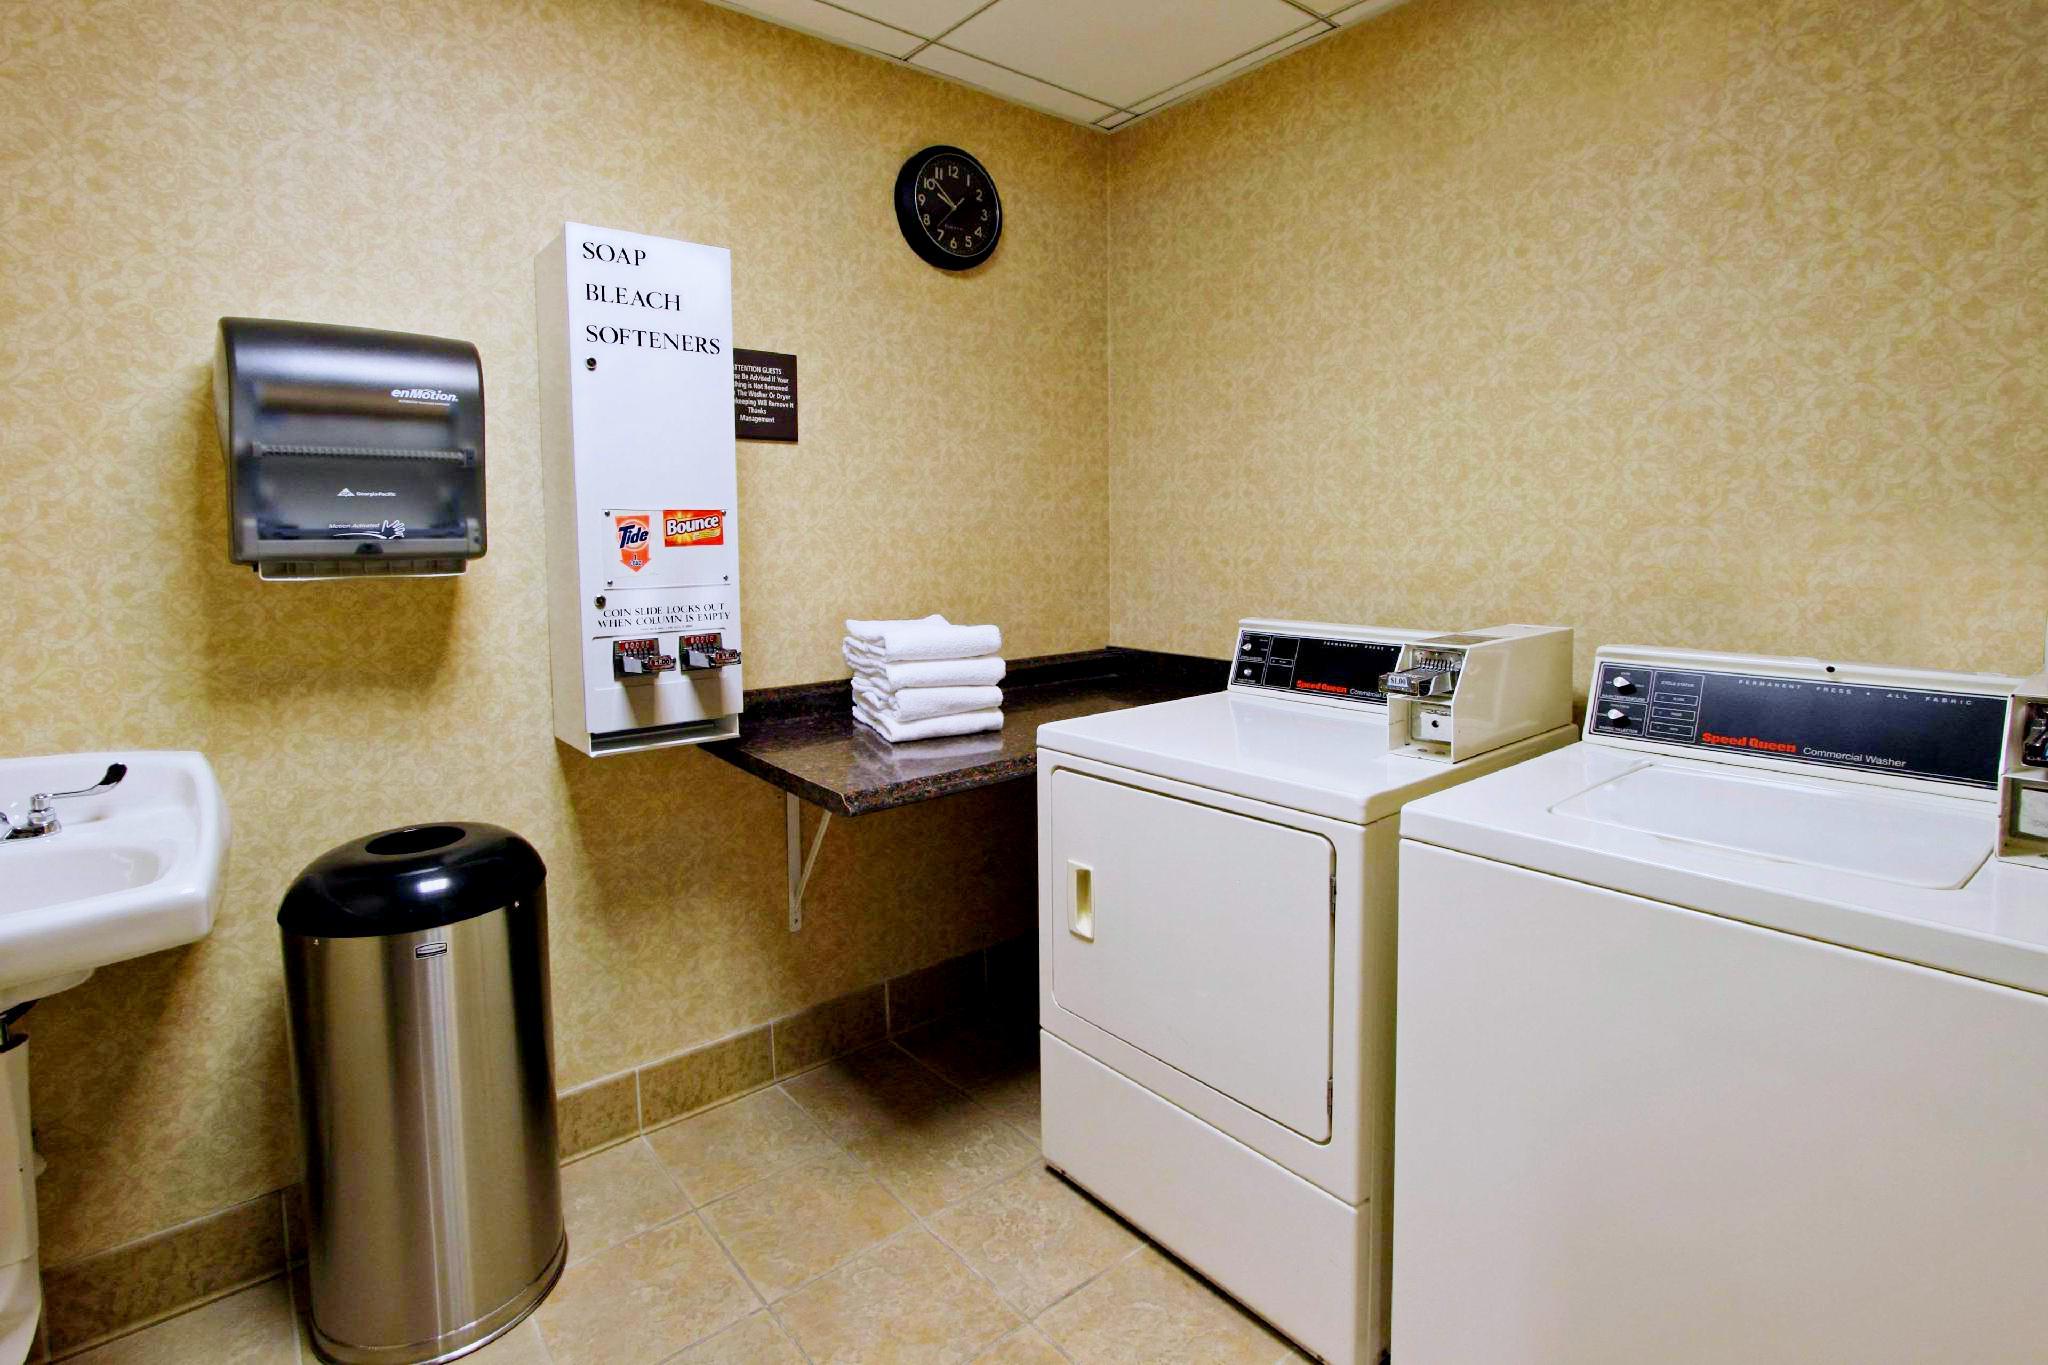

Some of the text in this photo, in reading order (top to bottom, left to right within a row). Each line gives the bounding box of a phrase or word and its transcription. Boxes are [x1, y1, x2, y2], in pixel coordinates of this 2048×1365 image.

[934, 166, 944, 180] 11
[948, 165, 960, 179] 12
[923, 177, 936, 190] 10
[966, 174, 971, 187] 1
[917, 193, 926, 206] 9
[975, 189, 984, 202] 2
[923, 213, 931, 226] 8
[980, 209, 988, 221] 3
[936, 229, 945, 241] 7
[974, 226, 983, 238] 4
[950, 236, 958, 249] 6
[964, 235, 973, 248] 5
[582, 241, 646, 267] SOAP
[585, 282, 682, 312] BLEACH
[586, 324, 721, 355] SOFTENERS
[734, 364, 782, 375] TTENTION GUESTS
[749, 374, 771, 382] Advised
[777, 376, 789, 384] Your
[764, 384, 789, 392] Removed
[737, 389, 791, 401] The Washer Or Dryer
[747, 406, 767, 415] Thanks
[768, 400, 789, 408] Remove
[739, 414, 775, 423] Management
[666, 515, 721, 537] Bounce
[618, 525, 649, 549] Tide
[603, 602, 725, 618] COIN SLIDE LOCKS OUT
[597, 618, 632, 628] WHEN
[636, 615, 682, 626] COLUMN
[685, 613, 694, 623] IS
[698, 611, 731, 622] EMPTY
[1296, 679, 1320, 691] Speed
[1321, 684, 1347, 696] Queen
[1349, 688, 1382, 699] Commercial
[1738, 679, 1973, 706] PERMANENT PRESS ALL FABRIC
[1701, 732, 1907, 768] Speed Queen Commercial Washer
